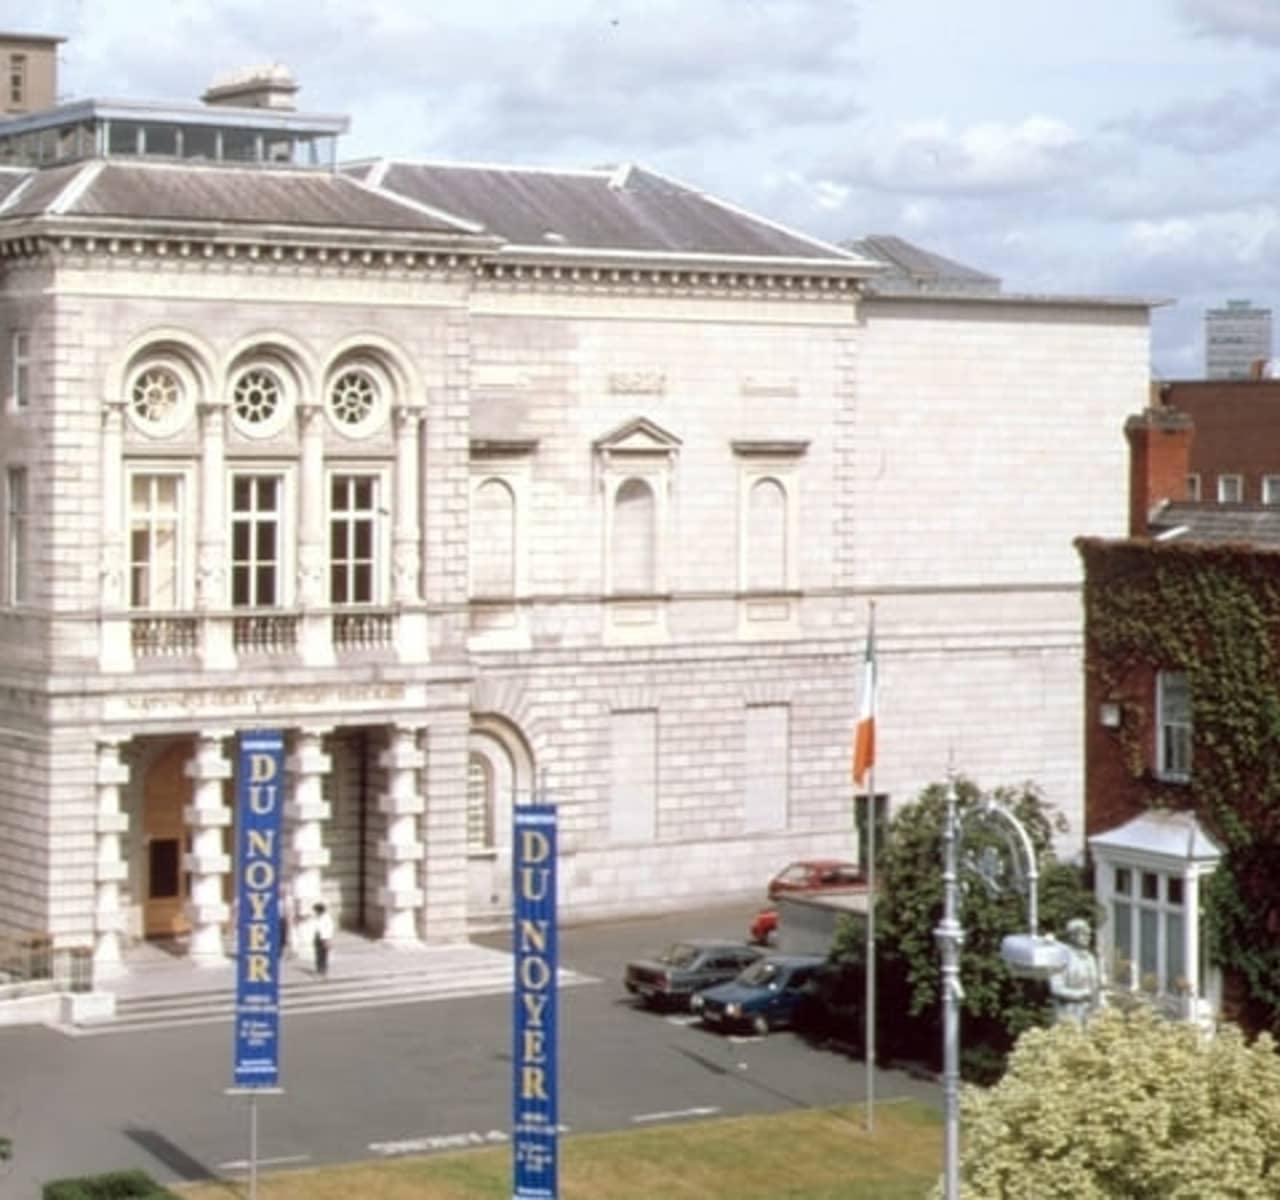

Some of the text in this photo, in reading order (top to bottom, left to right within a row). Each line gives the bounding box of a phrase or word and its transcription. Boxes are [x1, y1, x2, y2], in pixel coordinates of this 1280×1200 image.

[249, 754, 276, 814] DU
[245, 830, 275, 982] NOYER
[521, 831, 550, 900] DU
[520, 919, 550, 1099] NOYER
